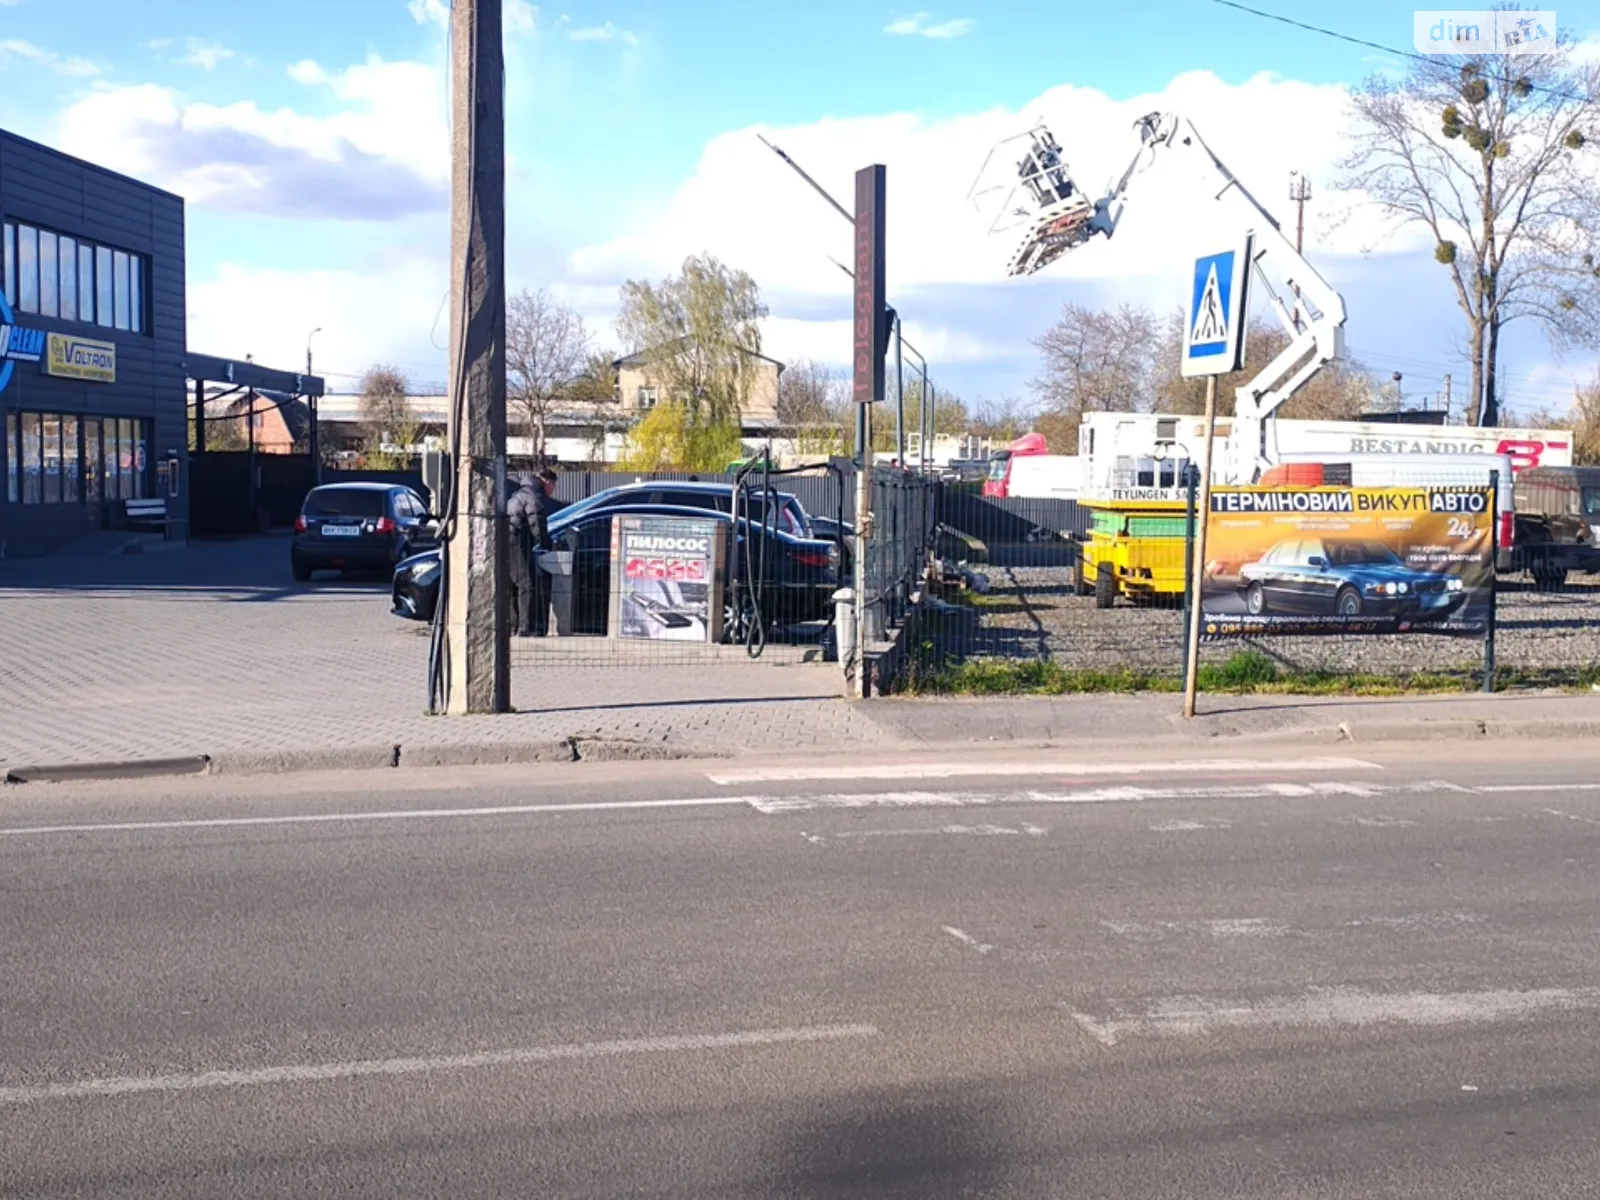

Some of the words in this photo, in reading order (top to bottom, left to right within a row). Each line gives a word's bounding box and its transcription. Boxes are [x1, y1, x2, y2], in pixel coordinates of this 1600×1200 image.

[1112, 489, 1168, 500] TEYLINGEN
[1213, 491, 1352, 511] ТЕРМІНОВИЙ
[1358, 494, 1427, 511] ВИКУП
[1431, 494, 1484, 511] АВТО
[627, 535, 708, 551] ПИЛОСОС
